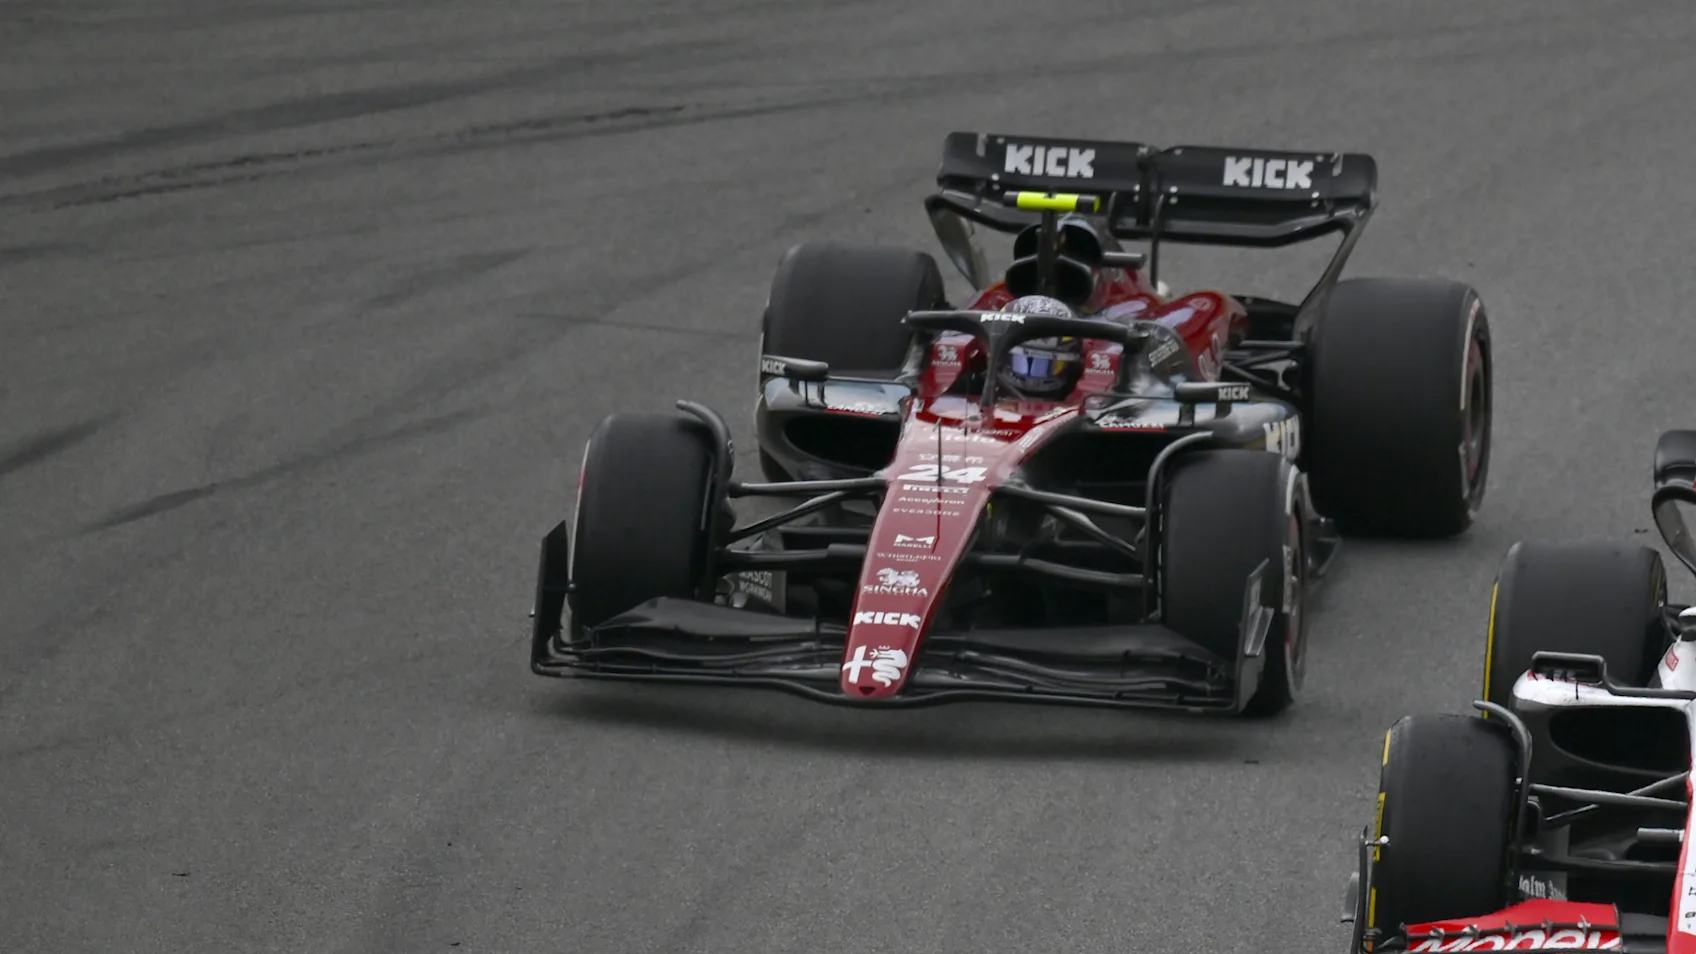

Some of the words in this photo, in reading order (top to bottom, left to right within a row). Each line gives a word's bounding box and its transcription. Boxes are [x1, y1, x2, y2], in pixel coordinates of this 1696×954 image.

[1004, 144, 1095, 178] KICK
[1223, 156, 1313, 189] KICK
[980, 312, 1026, 324] KICK
[762, 360, 786, 373] KICK
[1218, 386, 1250, 400] KICK
[897, 464, 988, 484] 24
[863, 584, 928, 597] SINGHA
[853, 612, 921, 630] KICK
